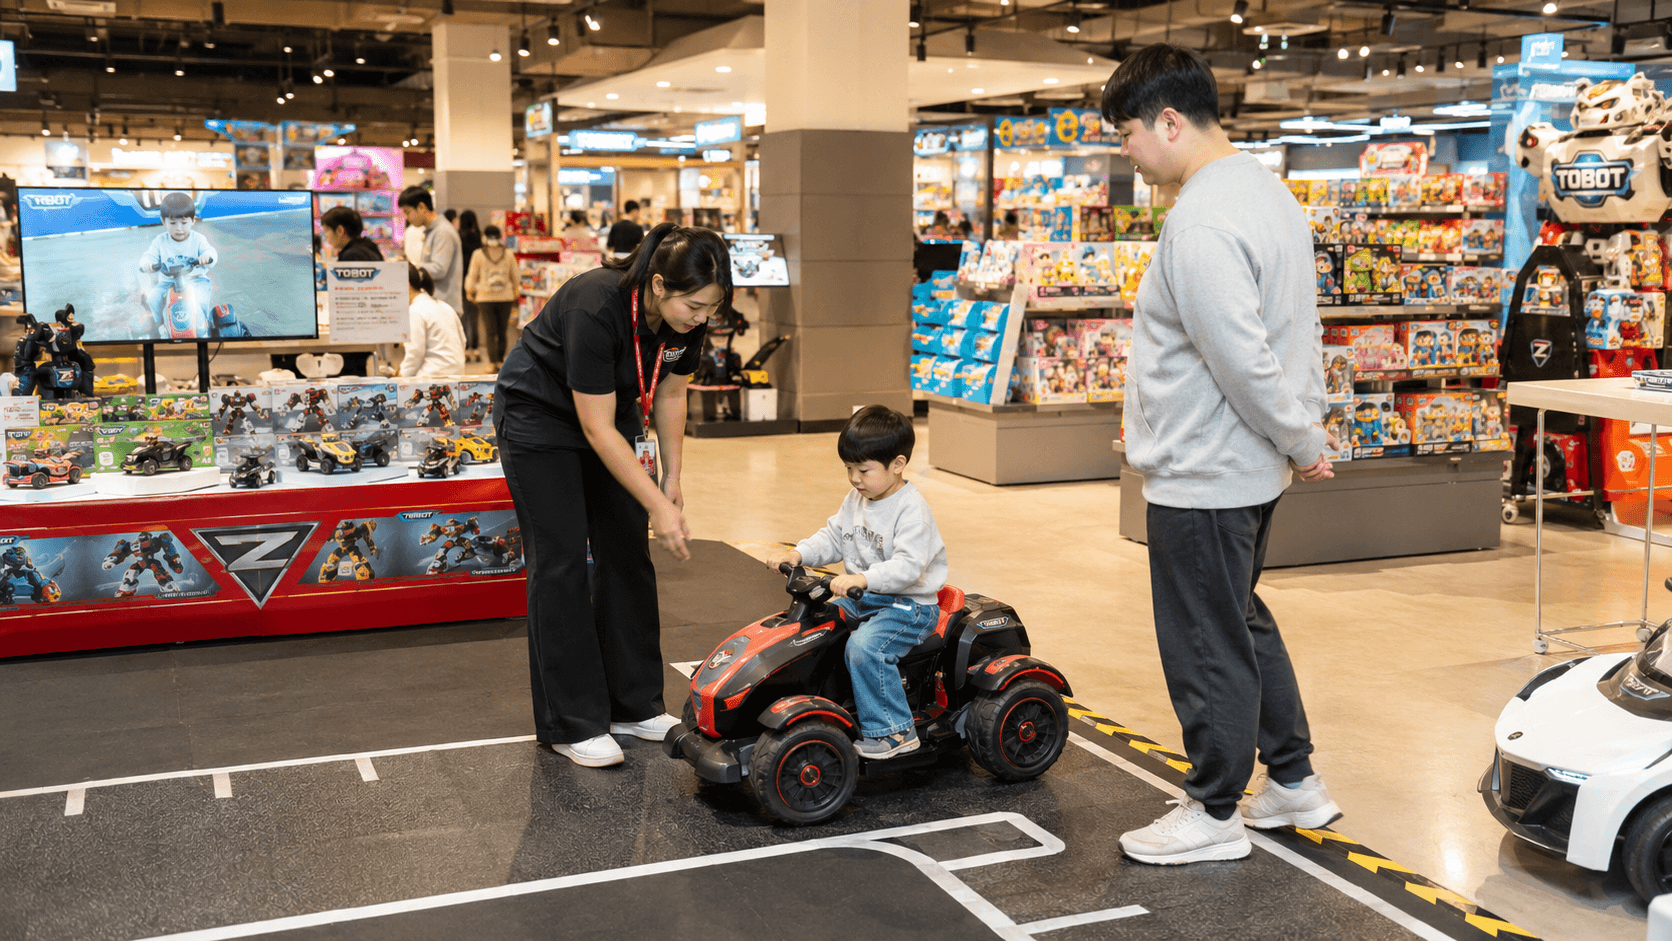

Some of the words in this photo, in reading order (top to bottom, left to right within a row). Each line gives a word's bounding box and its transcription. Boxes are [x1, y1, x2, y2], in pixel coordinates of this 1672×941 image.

[1556, 168, 1625, 189] TOBOT
[335, 269, 375, 278] TOBOT
[1533, 341, 1549, 358] Z
[214, 530, 299, 571] Z
